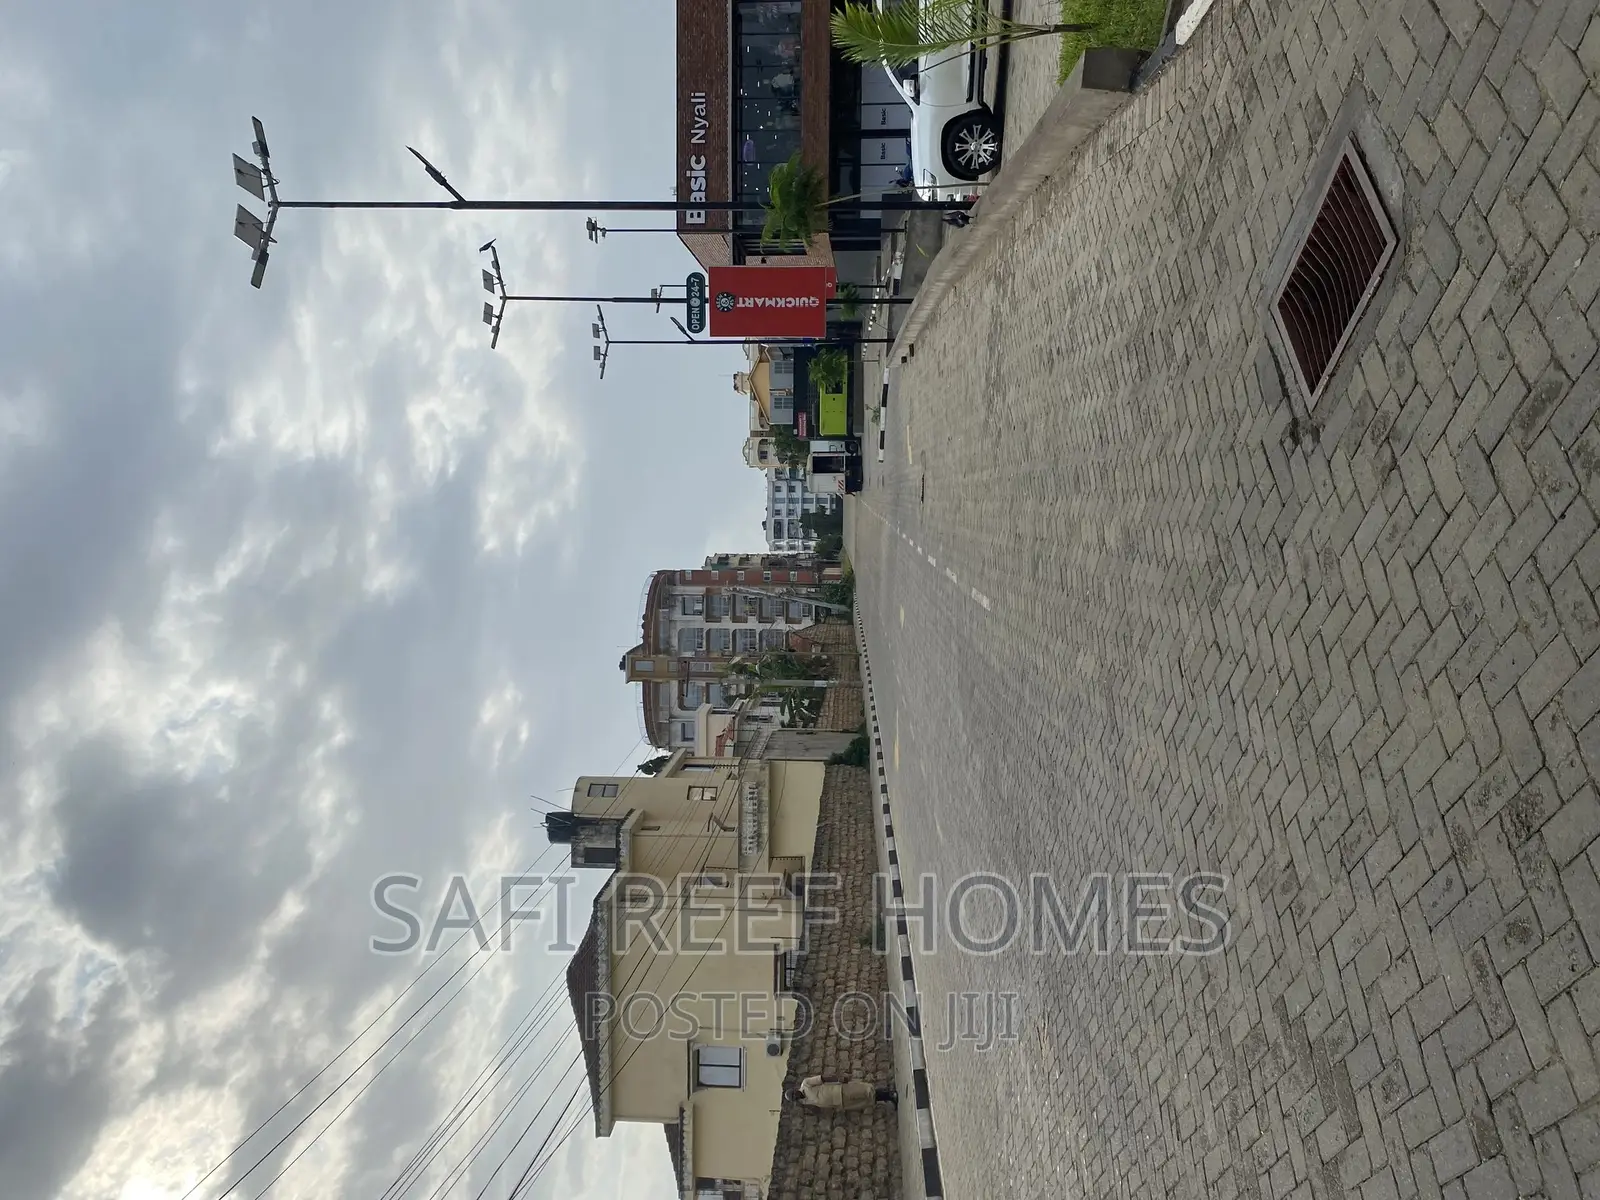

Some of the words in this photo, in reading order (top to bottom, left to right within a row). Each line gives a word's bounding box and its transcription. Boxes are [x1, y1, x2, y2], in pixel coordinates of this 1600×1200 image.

[690, 91, 712, 144] Nyali
[879, 107, 887, 126] Basic
[686, 154, 706, 225] Basic
[691, 277, 701, 299] 24-7
[737, 296, 820, 308] QUICKMART
[691, 307, 701, 331] OPEN
